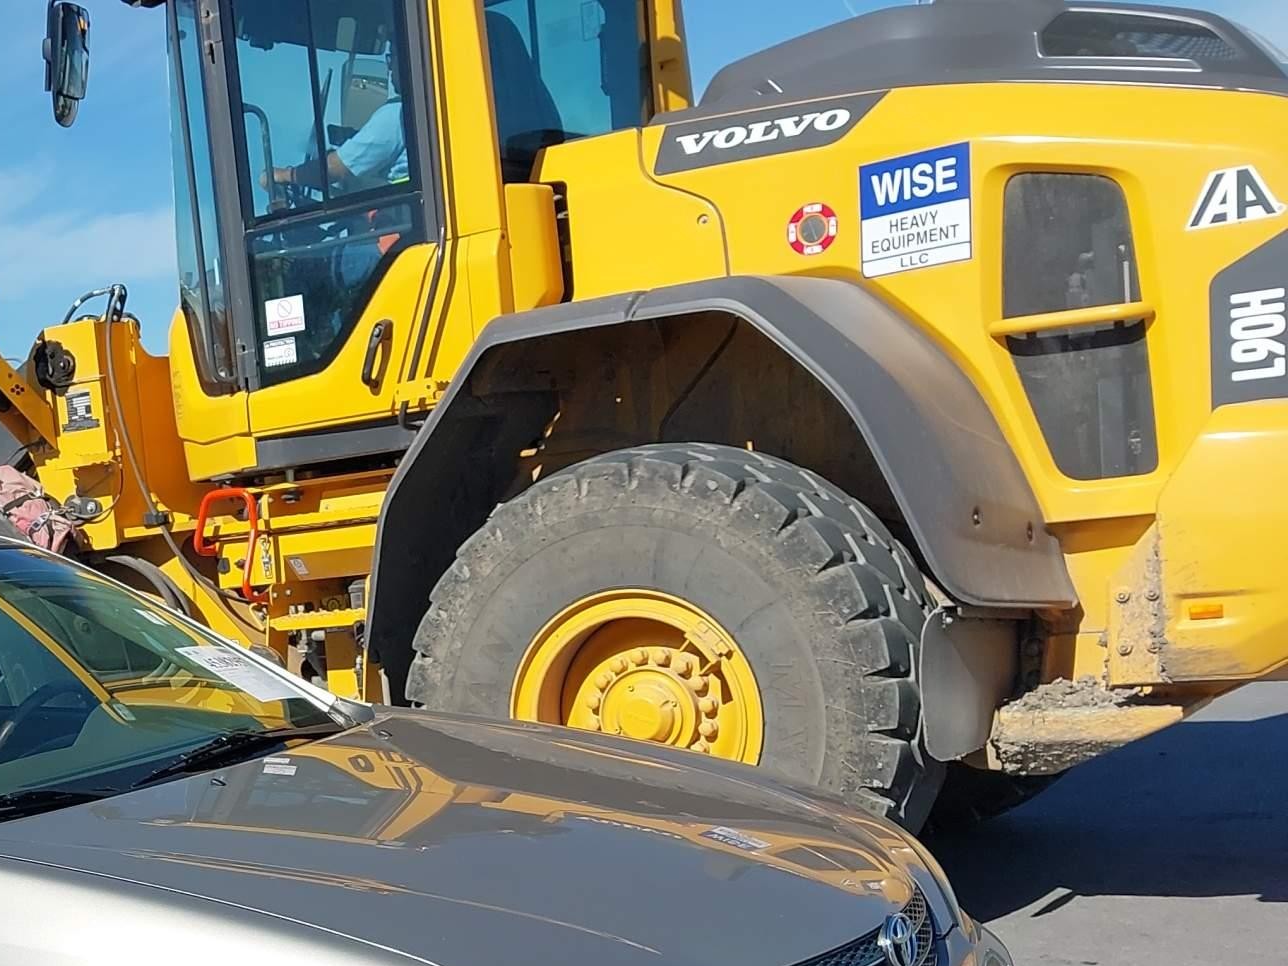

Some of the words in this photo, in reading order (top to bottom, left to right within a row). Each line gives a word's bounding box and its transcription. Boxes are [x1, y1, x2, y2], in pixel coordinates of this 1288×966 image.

[675, 108, 851, 155] VOLVO
[870, 156, 958, 207] WISE
[871, 223, 960, 254] EQUIPMENT
[889, 209, 939, 234] HEAVY
[900, 252, 929, 268] LLC
[1229, 287, 1287, 383] L90H
